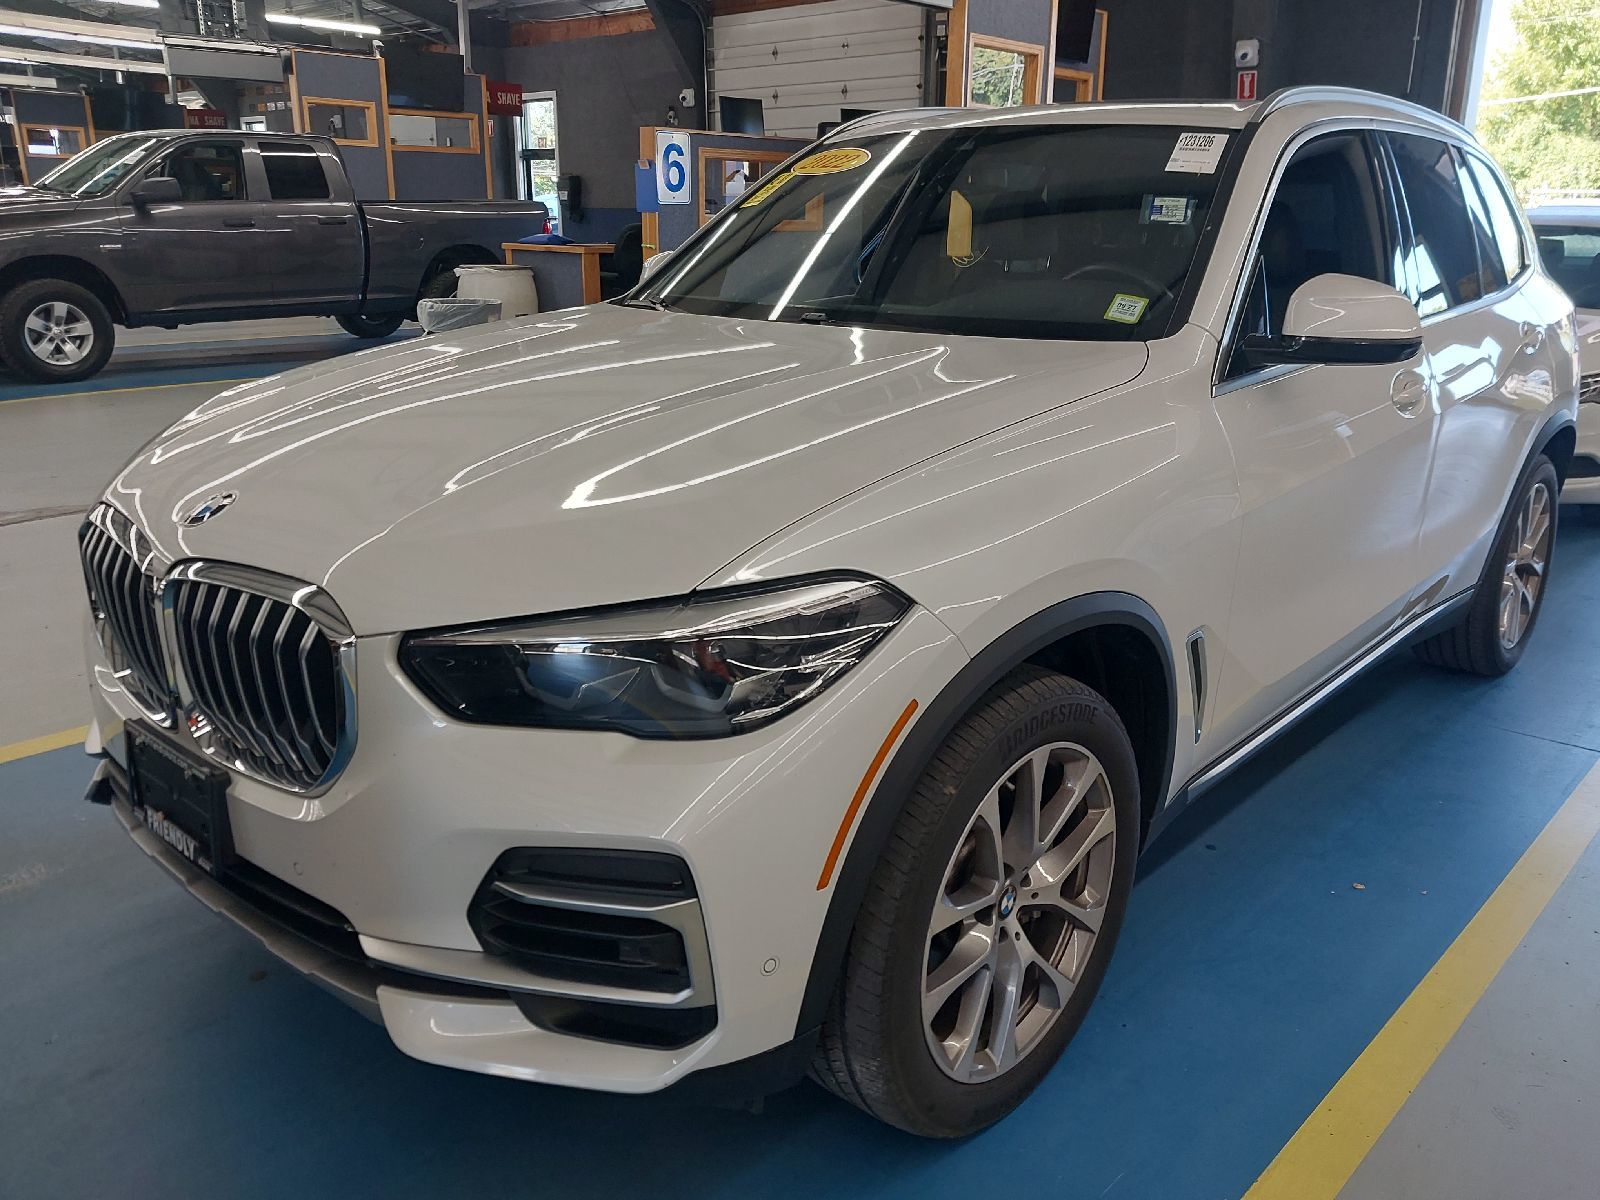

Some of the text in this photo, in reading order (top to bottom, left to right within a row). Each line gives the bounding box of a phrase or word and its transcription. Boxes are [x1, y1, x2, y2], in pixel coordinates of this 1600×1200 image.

[497, 92, 521, 106] SHAVE
[662, 143, 686, 193] 6
[799, 154, 862, 170] 2022
